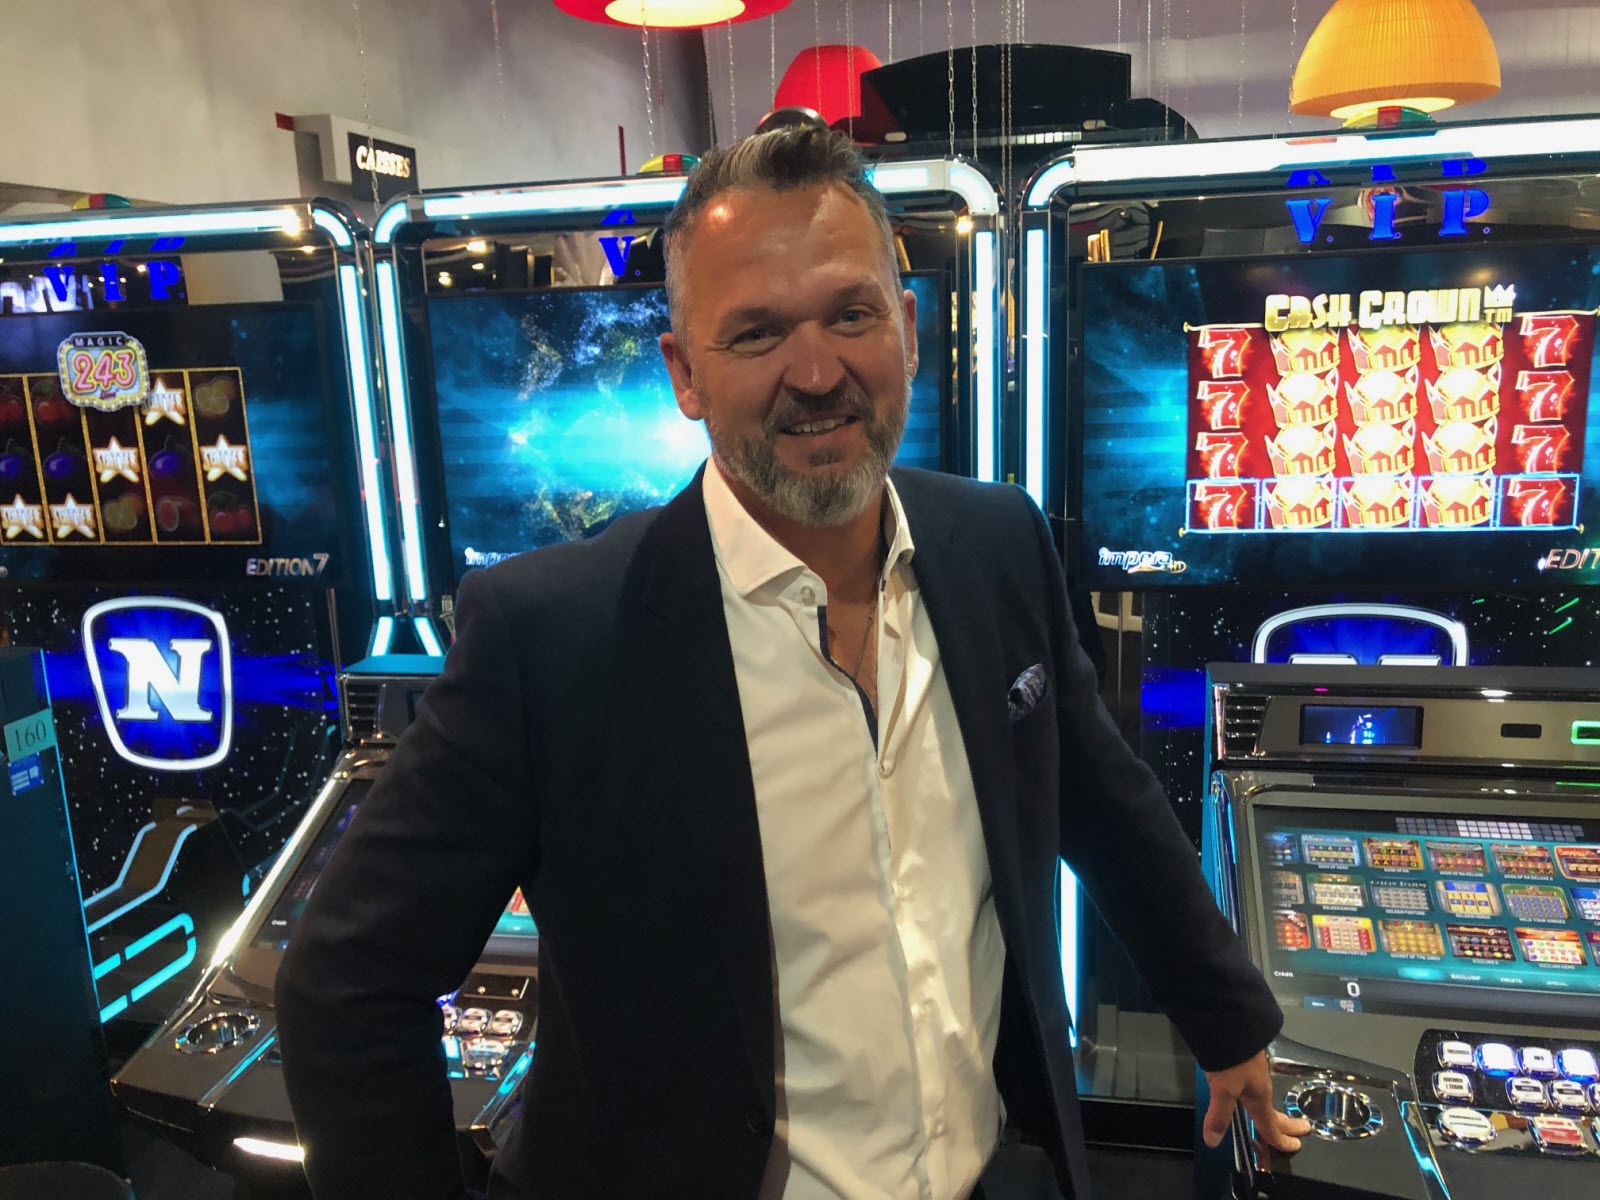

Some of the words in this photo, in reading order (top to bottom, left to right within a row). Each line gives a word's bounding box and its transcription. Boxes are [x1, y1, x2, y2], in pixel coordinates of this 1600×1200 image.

[1265, 294, 1351, 332] CASH
[1359, 287, 1482, 330] CROWN
[75, 336, 124, 347] MAGIC
[73, 351, 136, 391] 243
[108, 638, 213, 722] N
[15, 719, 47, 752] 160
[1346, 982, 1361, 997] 0
